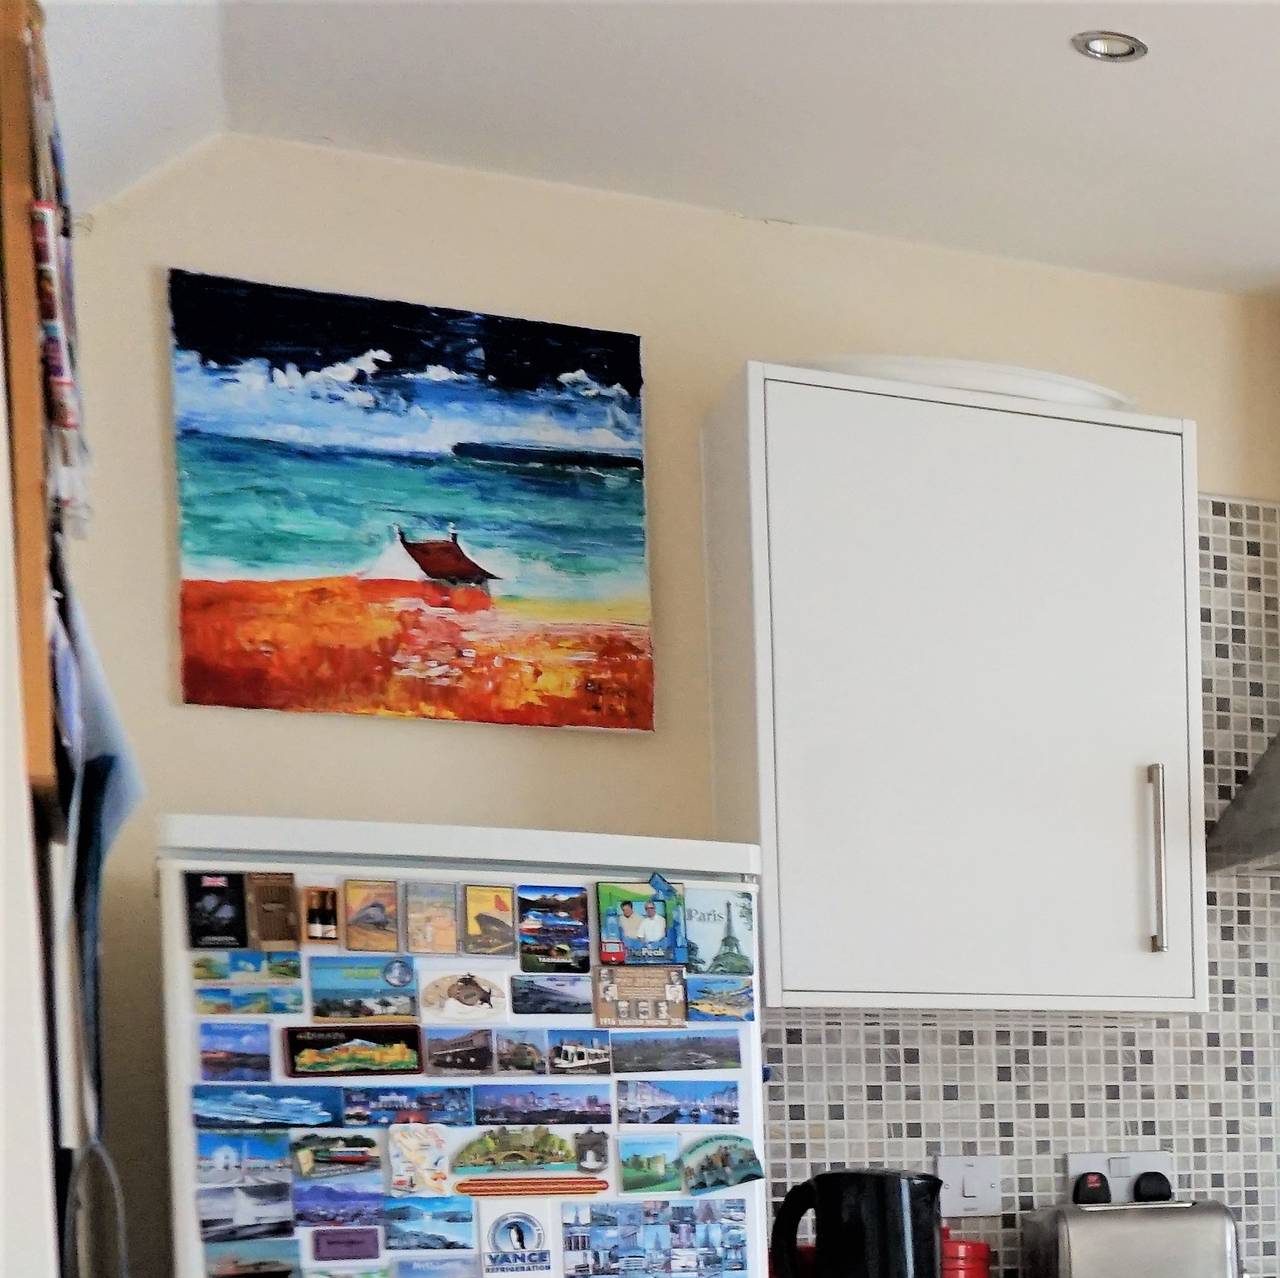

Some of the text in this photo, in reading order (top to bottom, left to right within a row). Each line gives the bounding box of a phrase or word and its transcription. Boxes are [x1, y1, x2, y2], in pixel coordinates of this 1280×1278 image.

[686, 908, 725, 922] Paris
[488, 1252, 548, 1265] VANCE
[485, 1264, 551, 1274] REFRIGERATION
